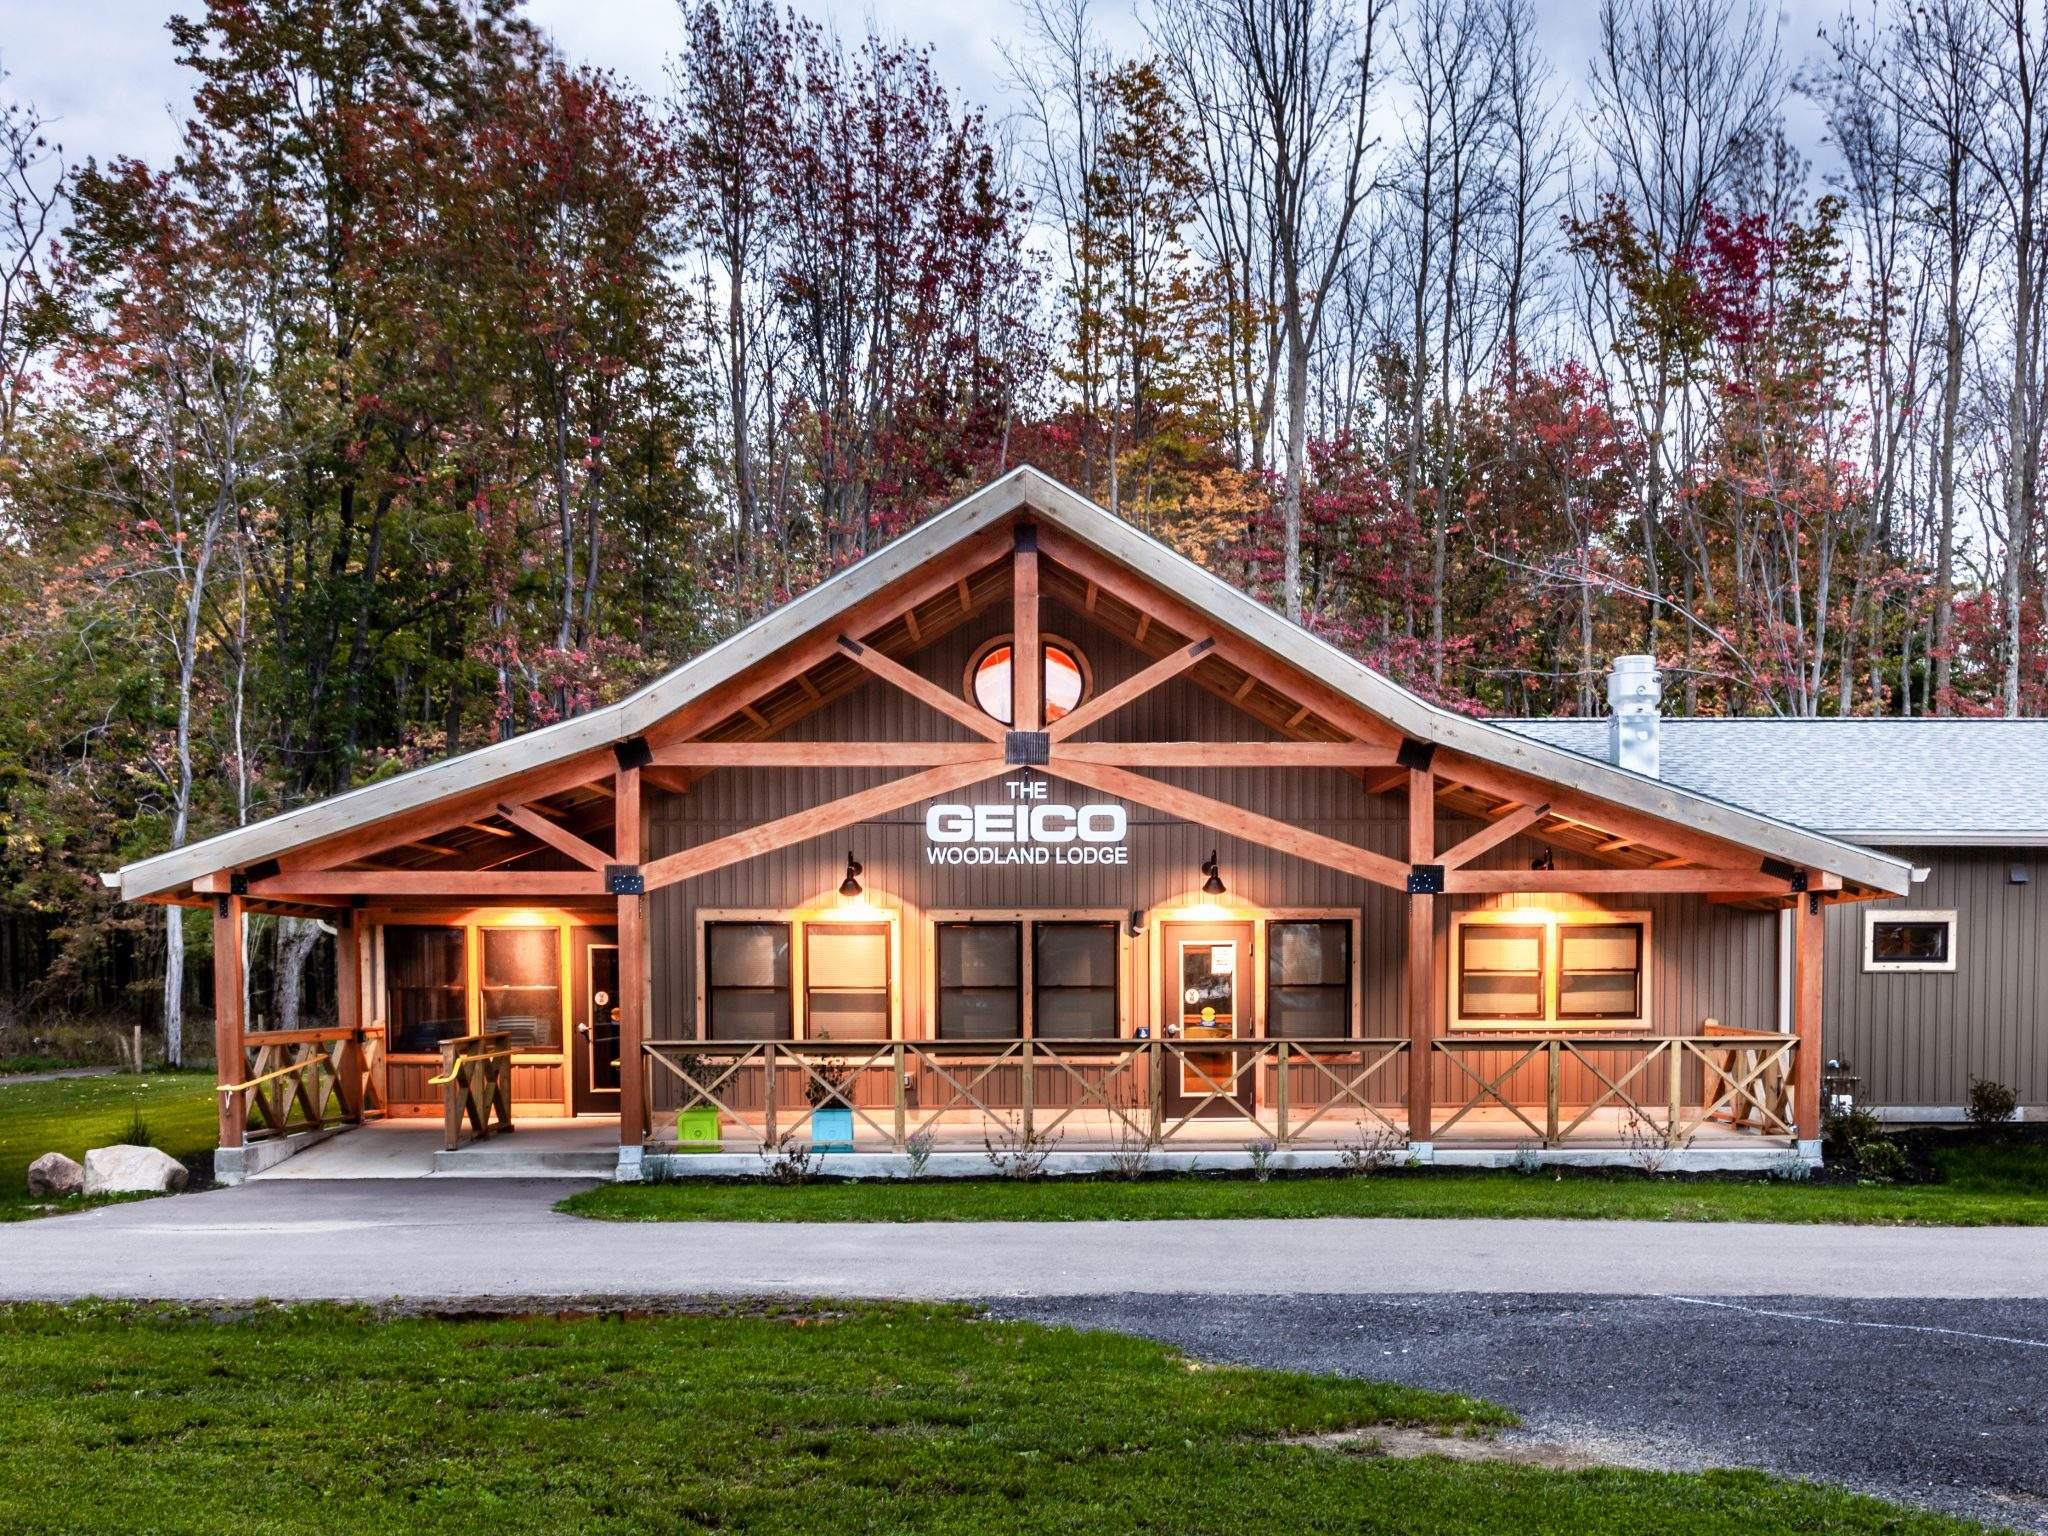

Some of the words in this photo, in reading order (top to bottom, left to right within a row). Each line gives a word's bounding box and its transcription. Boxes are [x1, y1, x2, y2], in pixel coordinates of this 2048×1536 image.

[1006, 781, 1048, 799] THE
[926, 804, 1127, 843] GEICO
[927, 847, 1049, 865] WOODLAND
[1056, 847, 1128, 865] LODGE
